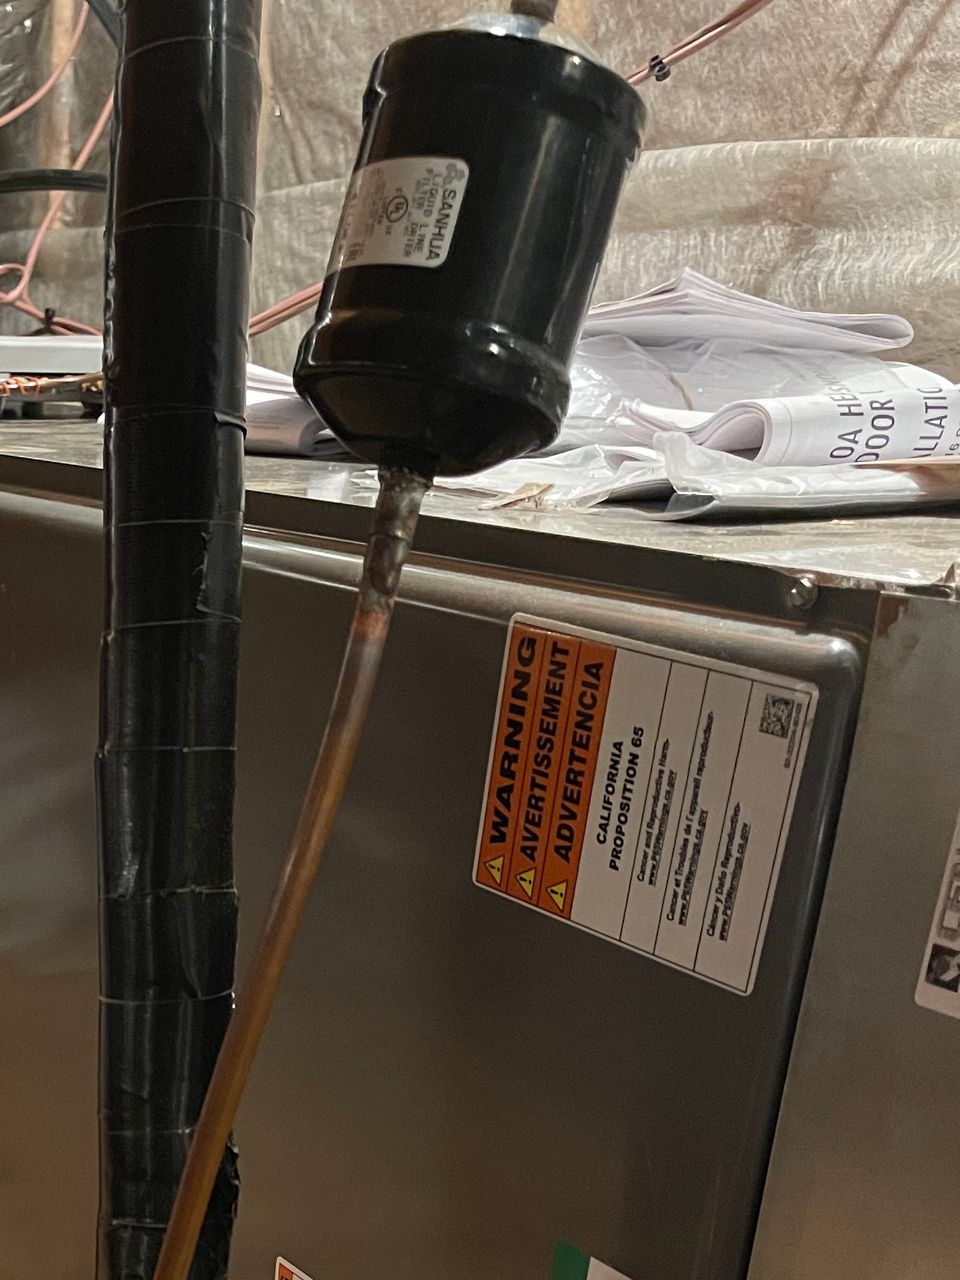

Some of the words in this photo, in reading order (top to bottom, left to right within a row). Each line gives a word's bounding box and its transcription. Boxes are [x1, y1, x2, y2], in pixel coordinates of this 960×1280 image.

[402, 222, 419, 256] DRIER
[413, 224, 429, 252] LINE
[425, 188, 457, 260] SANHUA
[489, 634, 537, 848] WARNING
[519, 640, 570, 863] AVERTISSEMENT
[552, 657, 603, 863] ADVERTENCIA
[595, 738, 625, 846] CALIFORNIA
[608, 751, 641, 872] PROPOSITION
[630, 725, 645, 749] 65
[646, 768, 667, 830] Reproductive
[643, 828, 654, 849] and
[683, 822, 692, 835] de
[636, 849, 649, 882] Cancer
[674, 836, 690, 877] Troubles
[672, 877, 681, 888] et
[714, 869, 728, 895] Daño
[665, 889, 679, 922] Cancer
